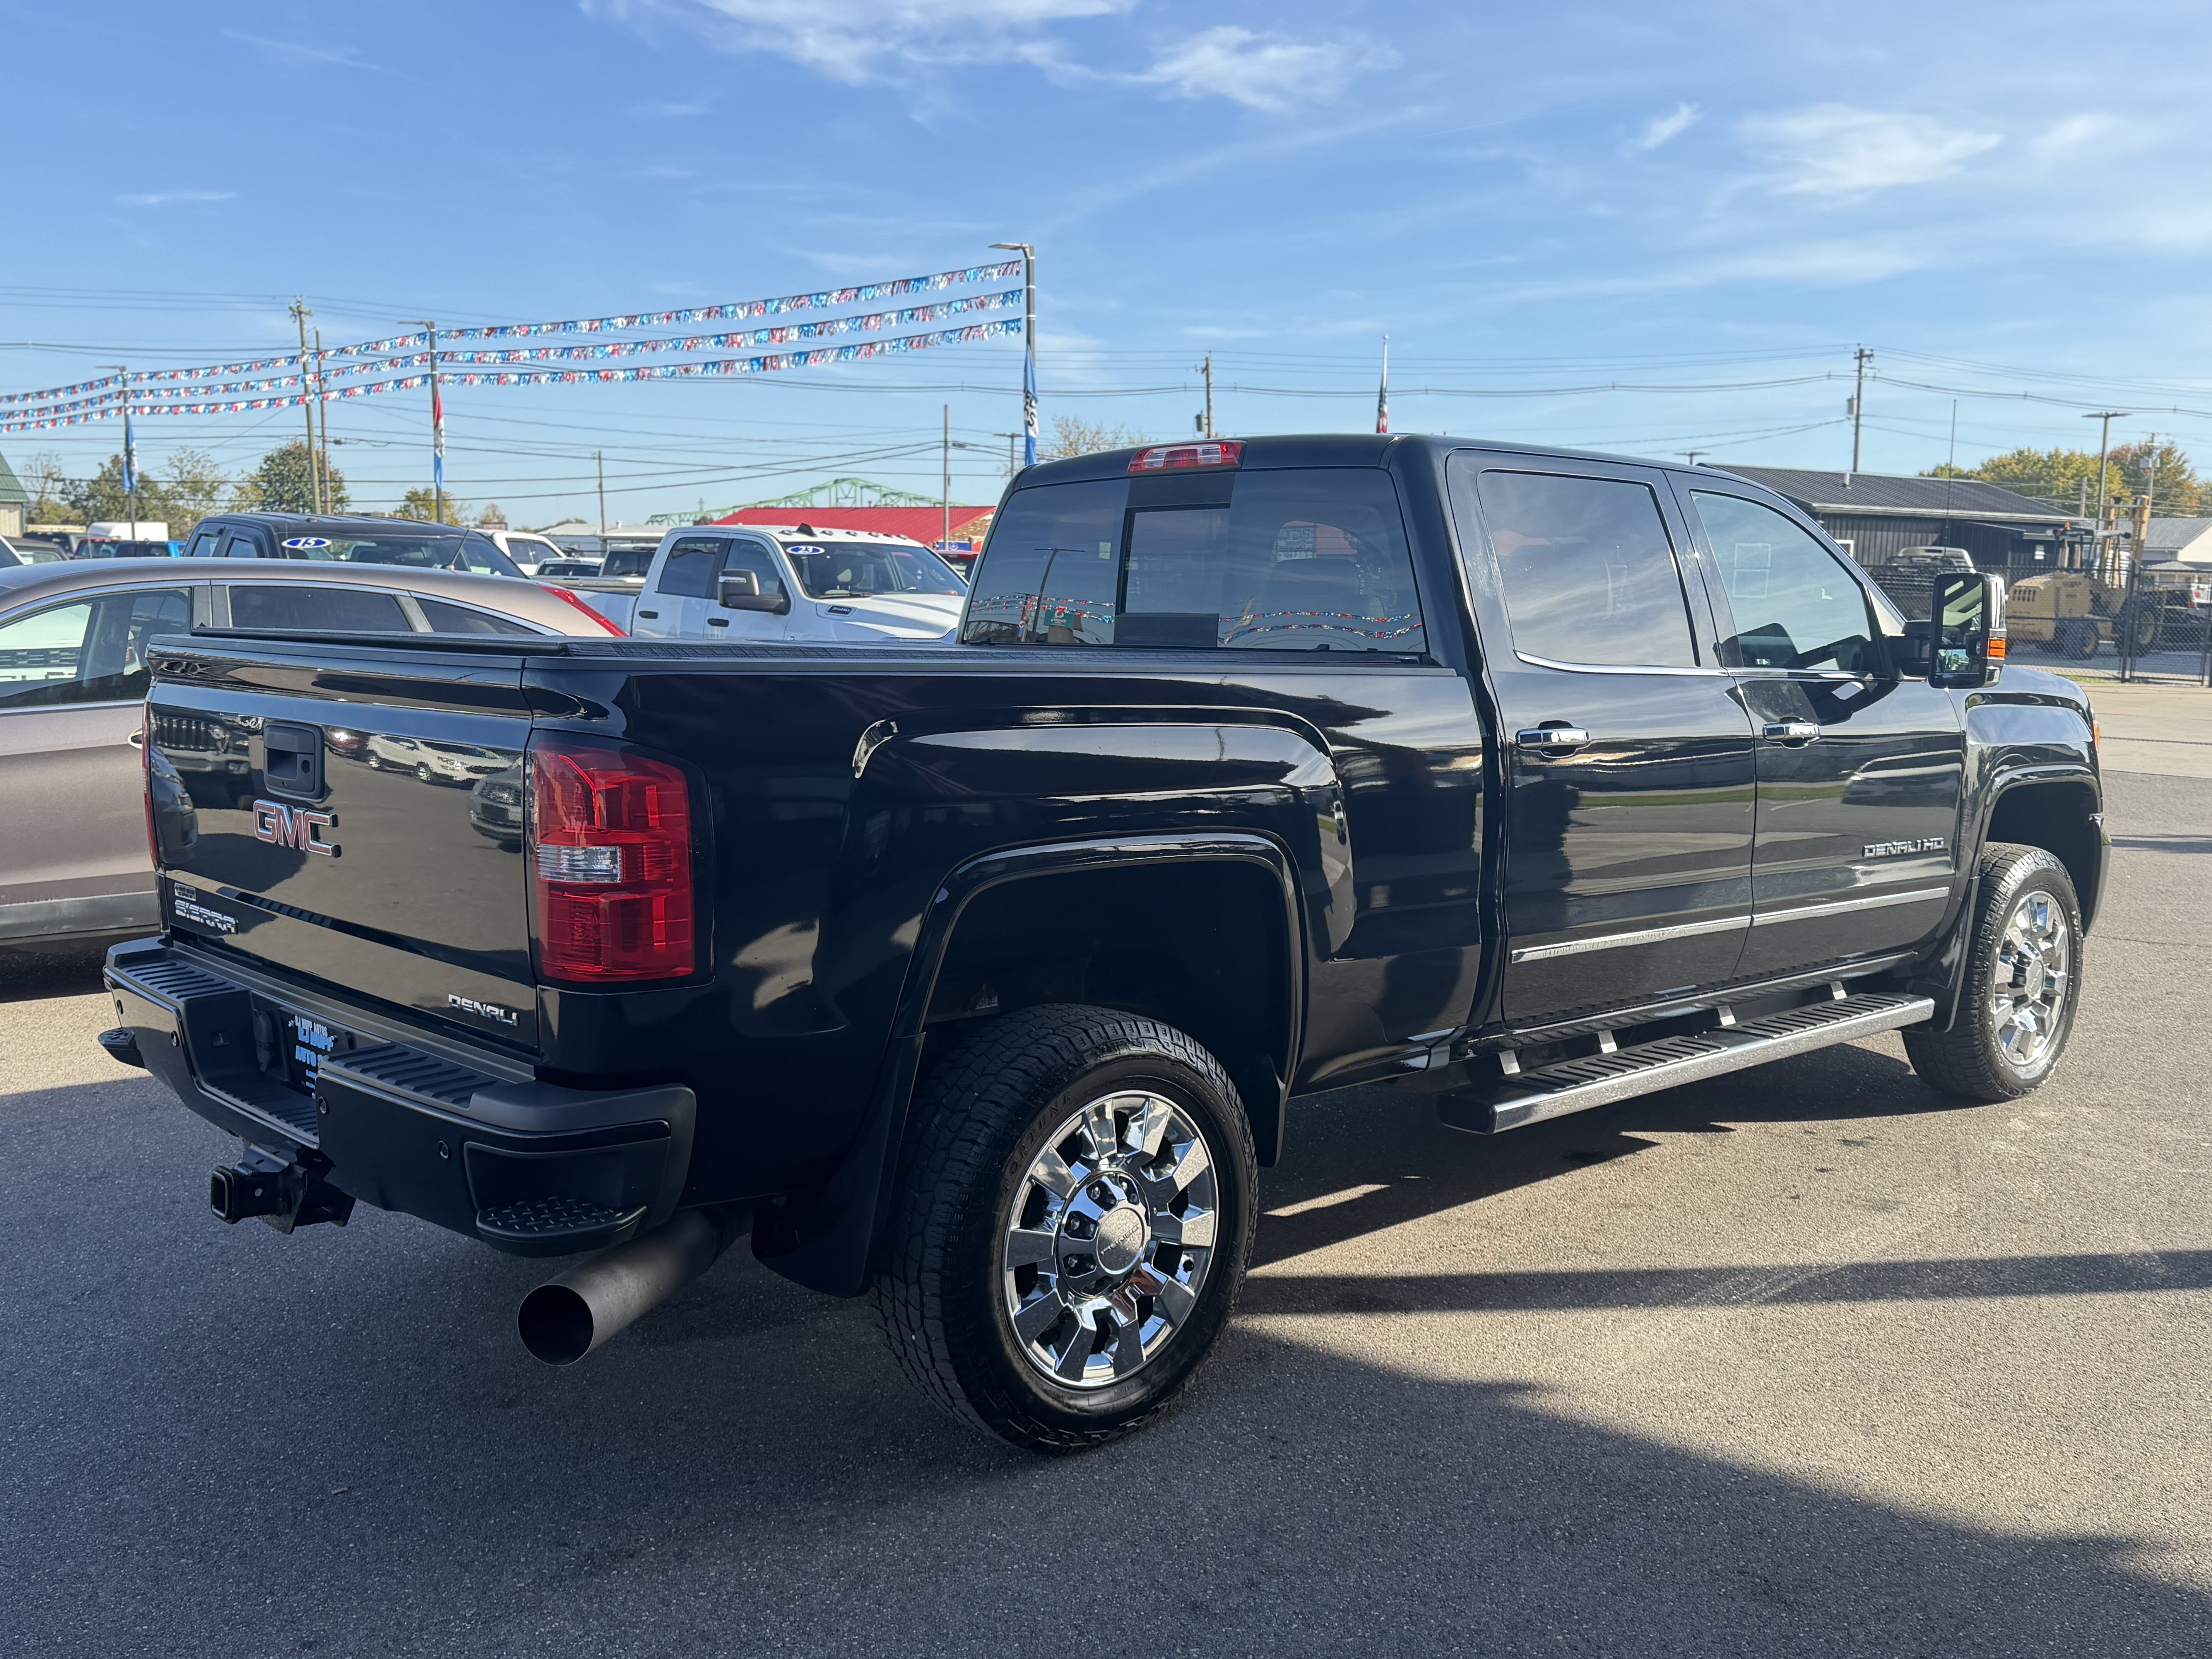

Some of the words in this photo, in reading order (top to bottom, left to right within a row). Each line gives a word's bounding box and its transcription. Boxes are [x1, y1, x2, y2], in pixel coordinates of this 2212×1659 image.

[253, 799, 342, 858] GMC
[1862, 840, 1921, 857] DENALI
[1923, 837, 1944, 851] HD
[175, 899, 238, 934] SIERRA
[448, 994, 519, 1026] DENALI
